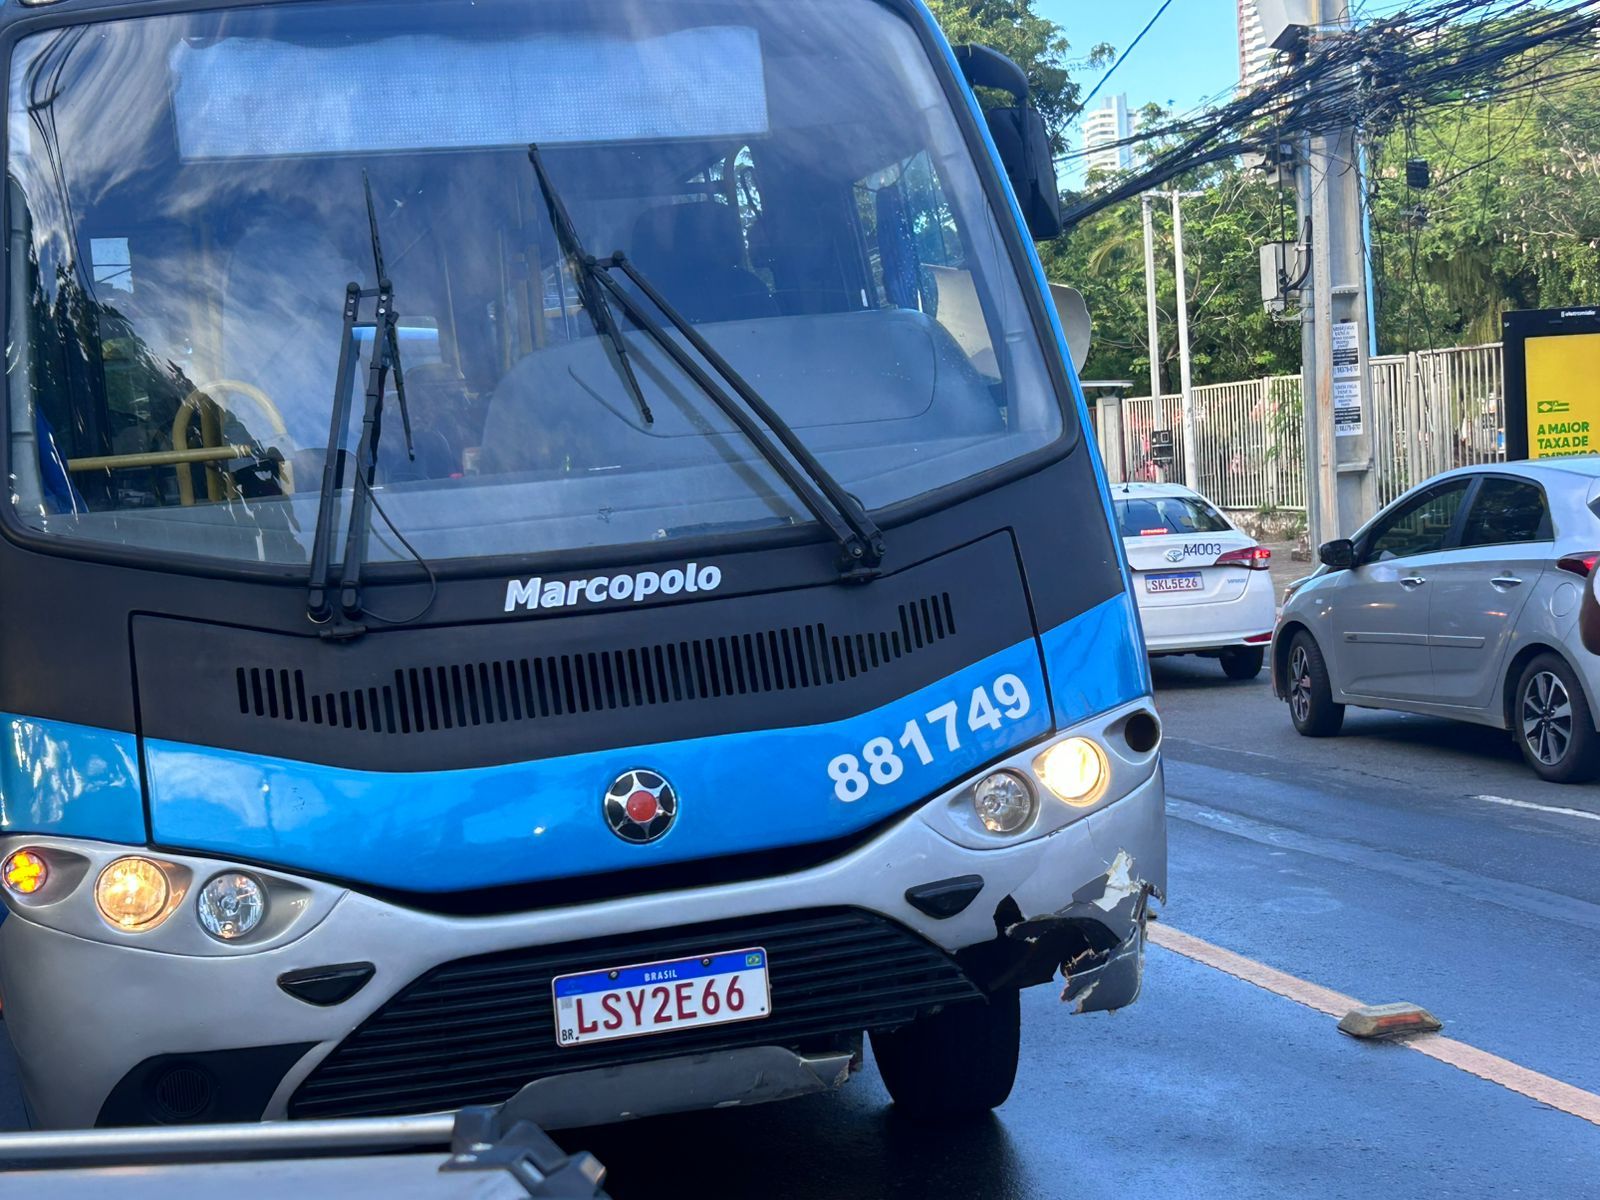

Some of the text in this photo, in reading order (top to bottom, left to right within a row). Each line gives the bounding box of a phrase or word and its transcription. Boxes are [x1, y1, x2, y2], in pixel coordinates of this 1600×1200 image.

[1537, 421, 1590, 435] A MAIOR
[1537, 435, 1588, 449] TAXA DE
[1183, 543, 1221, 556] A4003
[504, 563, 722, 612] Marcopolo
[1151, 577, 1198, 591] SKL5E26
[827, 673, 1030, 803] 881749
[644, 969, 677, 982] BRASIL
[576, 975, 744, 1035] LSY2E66
[561, 1028, 574, 1042] BR
